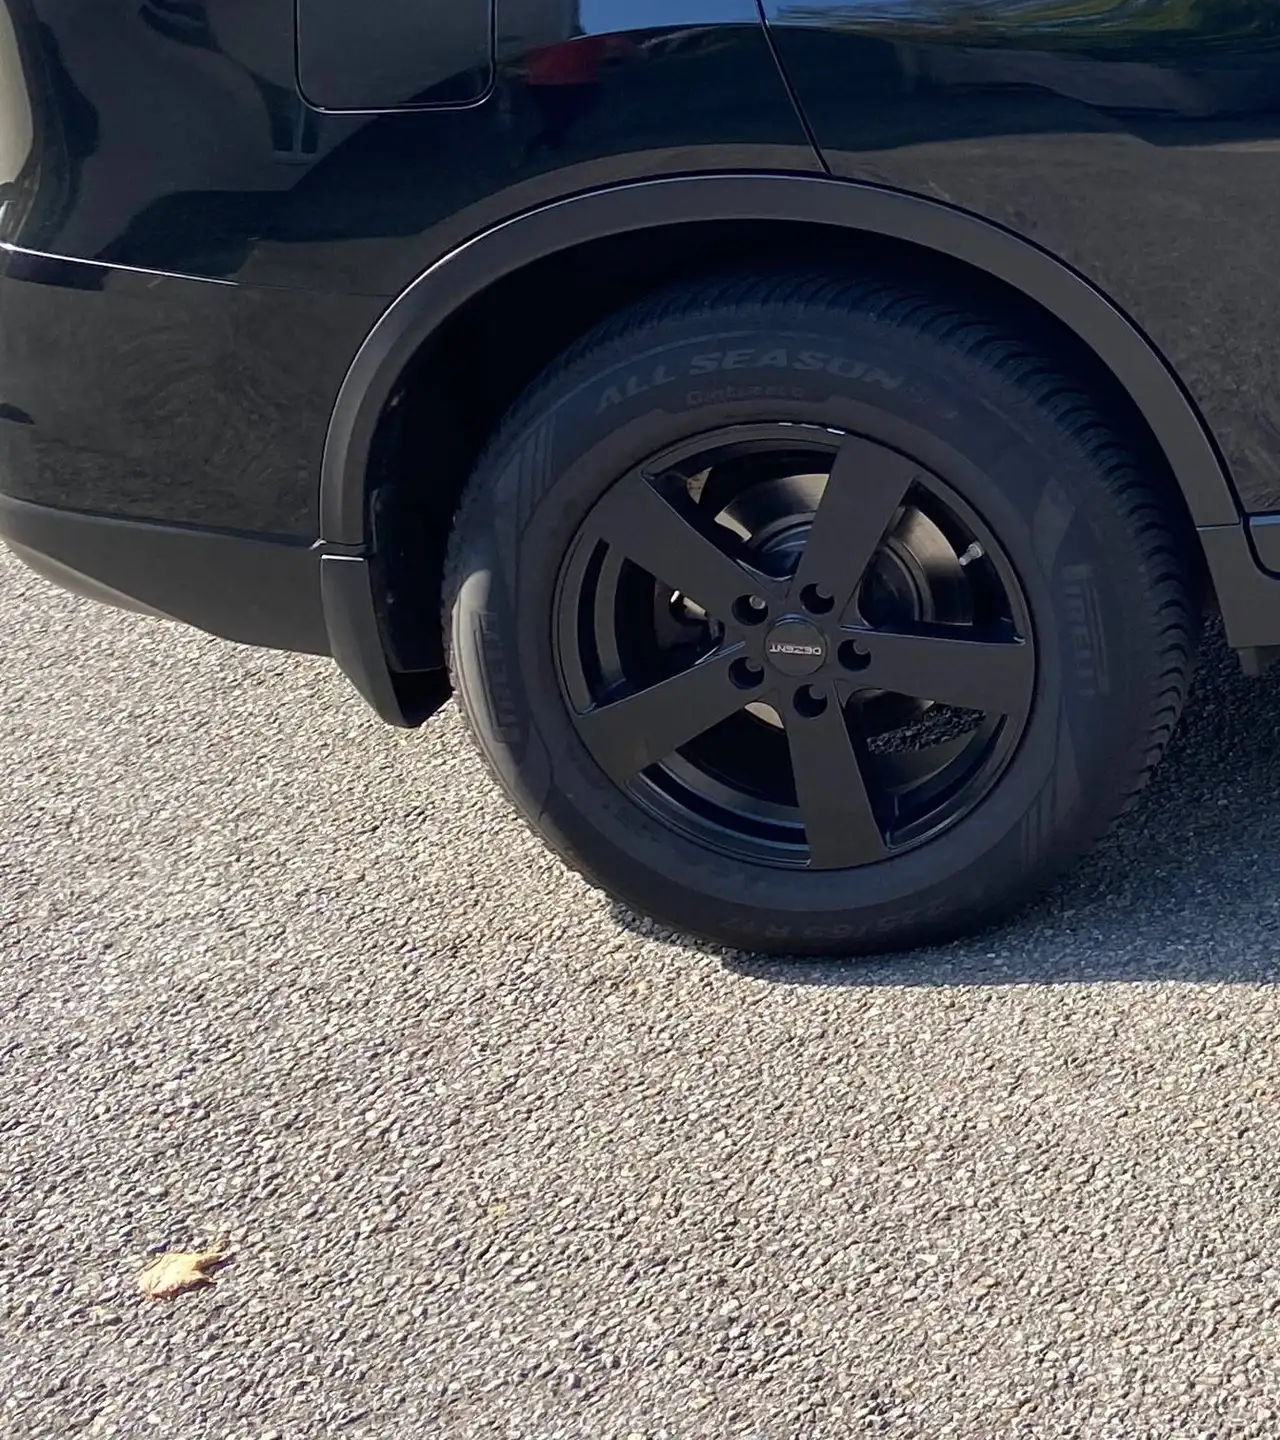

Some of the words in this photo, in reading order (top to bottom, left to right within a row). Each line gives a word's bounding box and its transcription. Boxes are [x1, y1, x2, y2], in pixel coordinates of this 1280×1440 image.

[595, 364, 677, 417] ALL
[690, 347, 906, 392] SEASON
[769, 644, 822, 656] DEZENT
